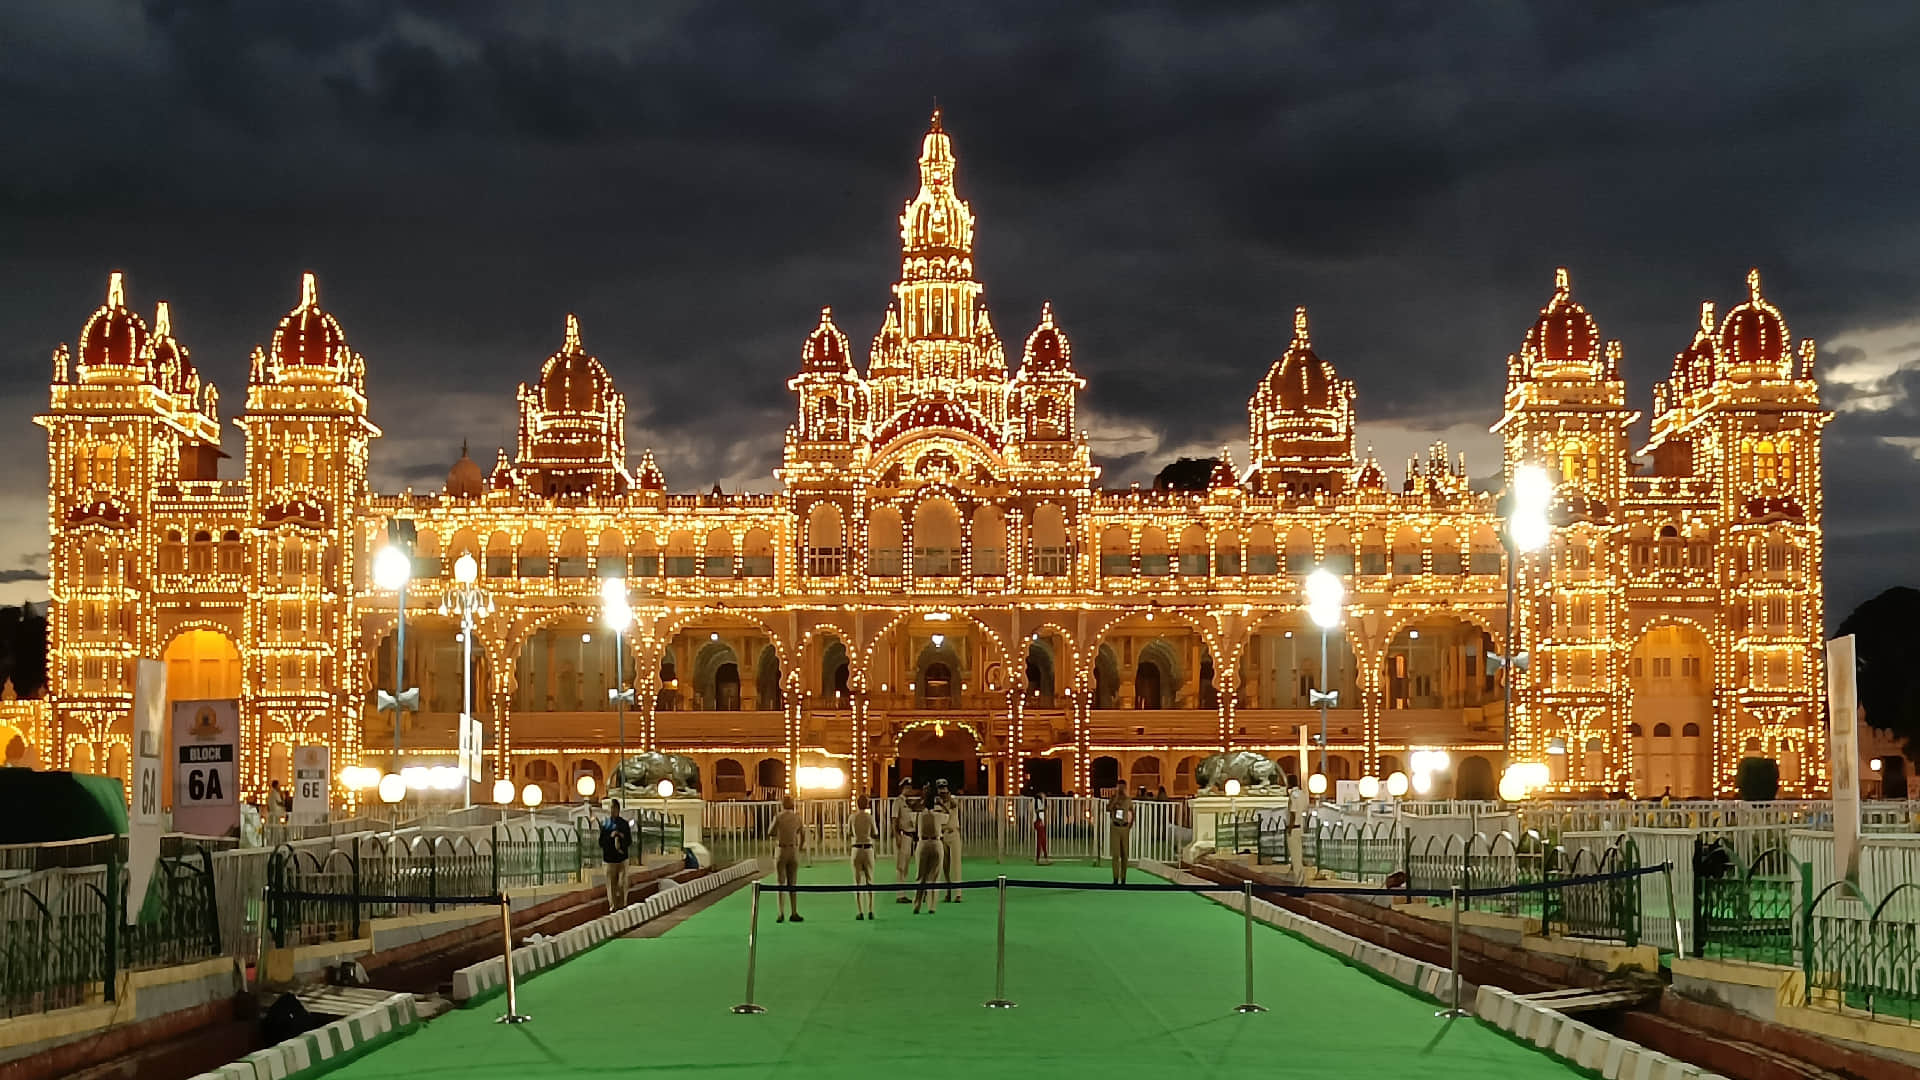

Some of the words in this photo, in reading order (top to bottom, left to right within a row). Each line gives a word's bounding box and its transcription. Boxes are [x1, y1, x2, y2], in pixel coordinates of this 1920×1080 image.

[190, 747, 221, 761] BLOCK
[142, 768, 156, 815] 6A
[189, 768, 224, 801] 6A
[303, 782, 320, 798] 6E
